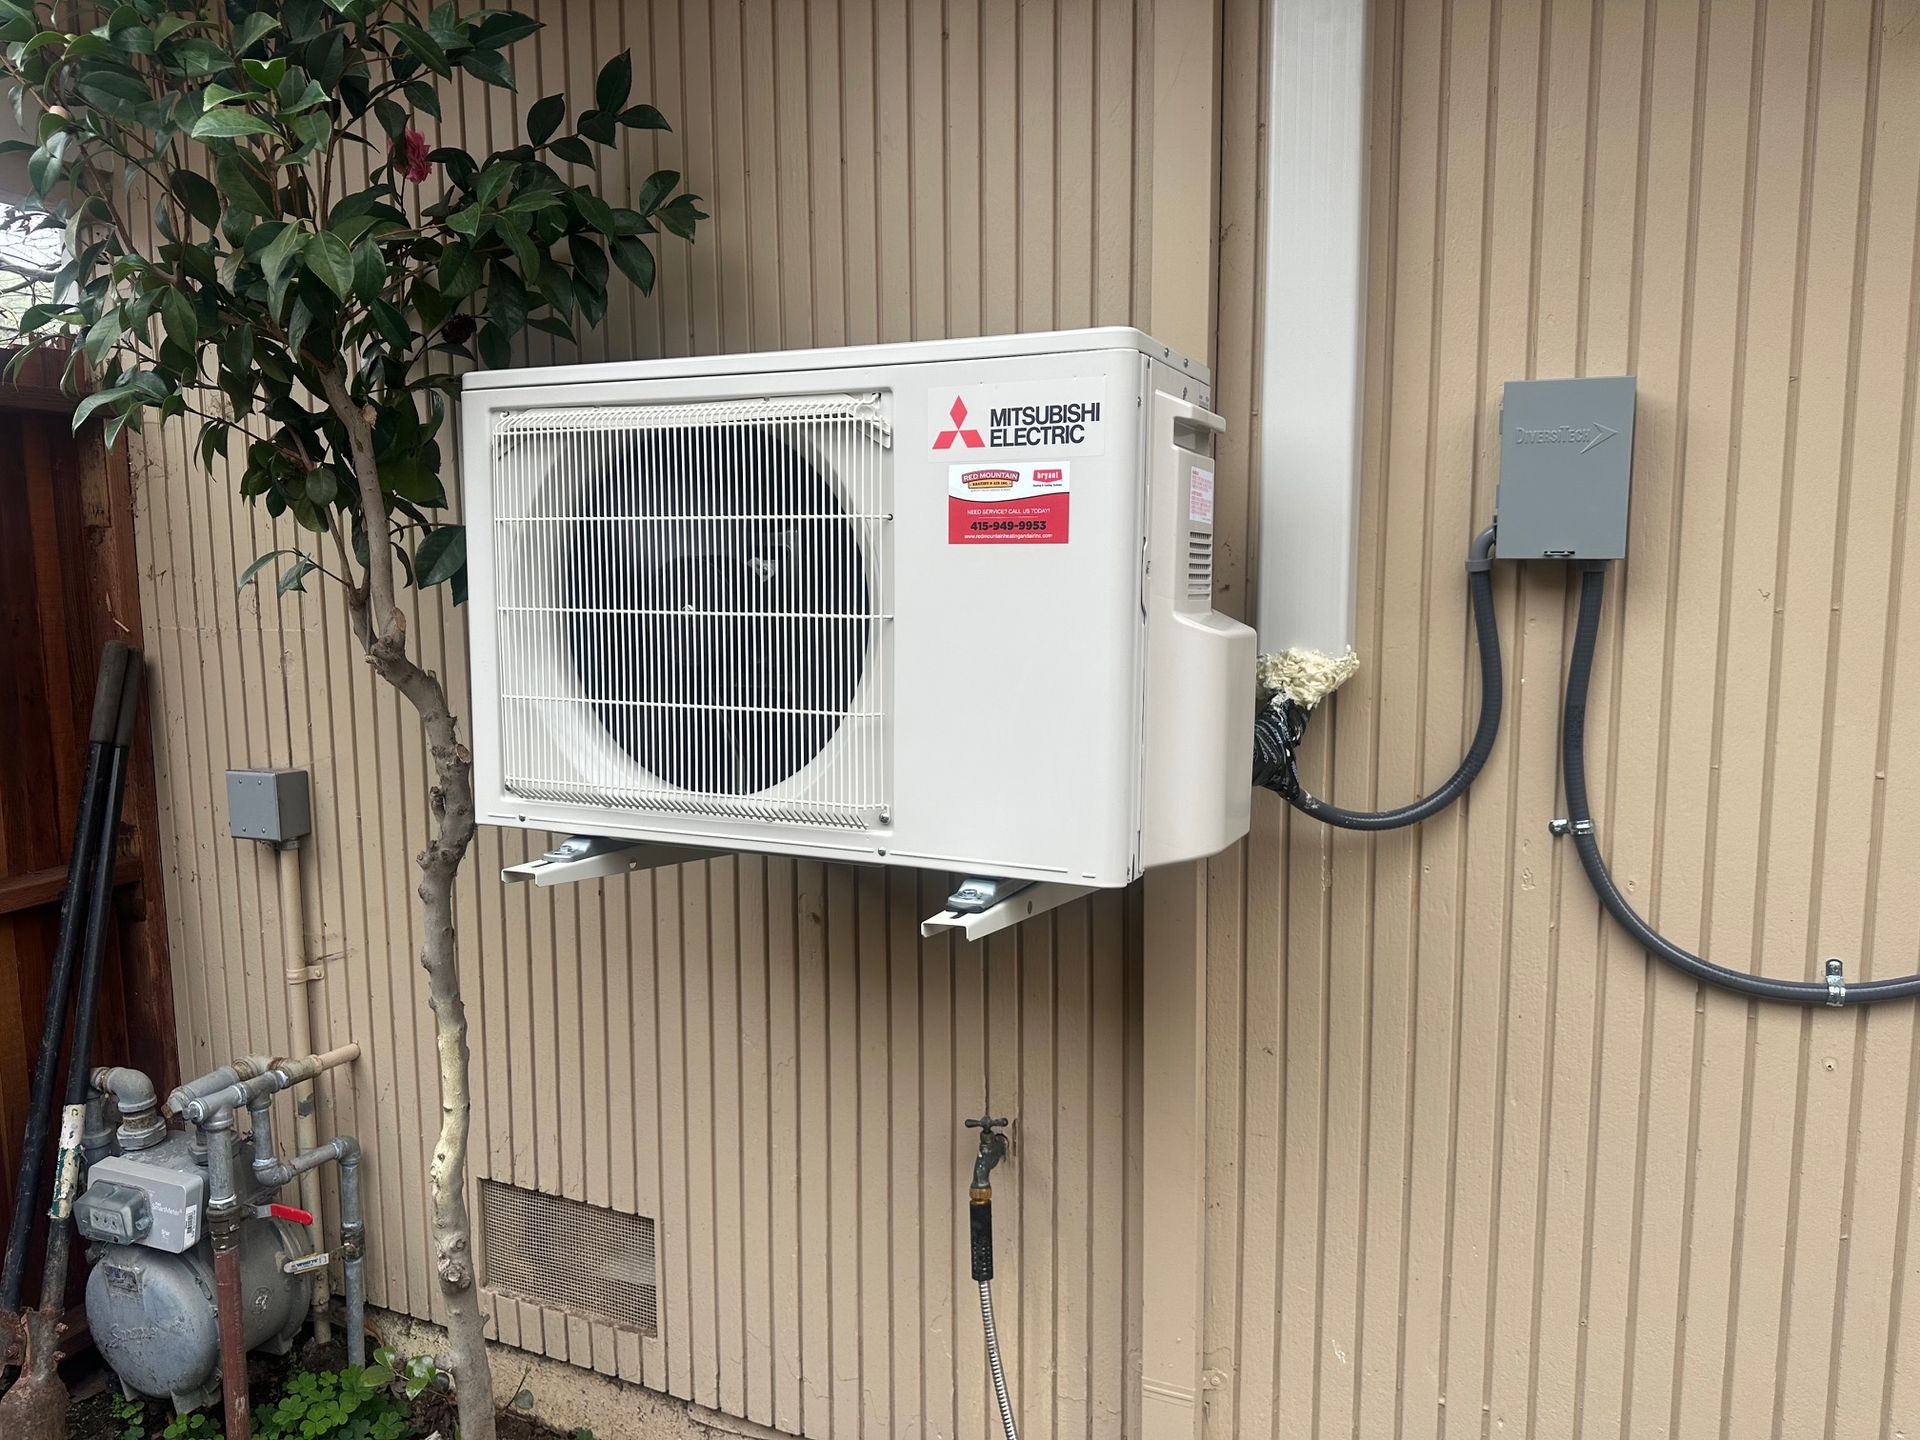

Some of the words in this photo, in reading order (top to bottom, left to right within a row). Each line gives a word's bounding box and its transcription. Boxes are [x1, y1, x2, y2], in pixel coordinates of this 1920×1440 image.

[990, 403, 1100, 427] MITSUBISHI
[990, 425, 1085, 447] ELECTRIC
[963, 473, 979, 481] RED
[979, 471, 1018, 480] MOUNTAIN
[970, 521, 1046, 530] 415-949-9953
